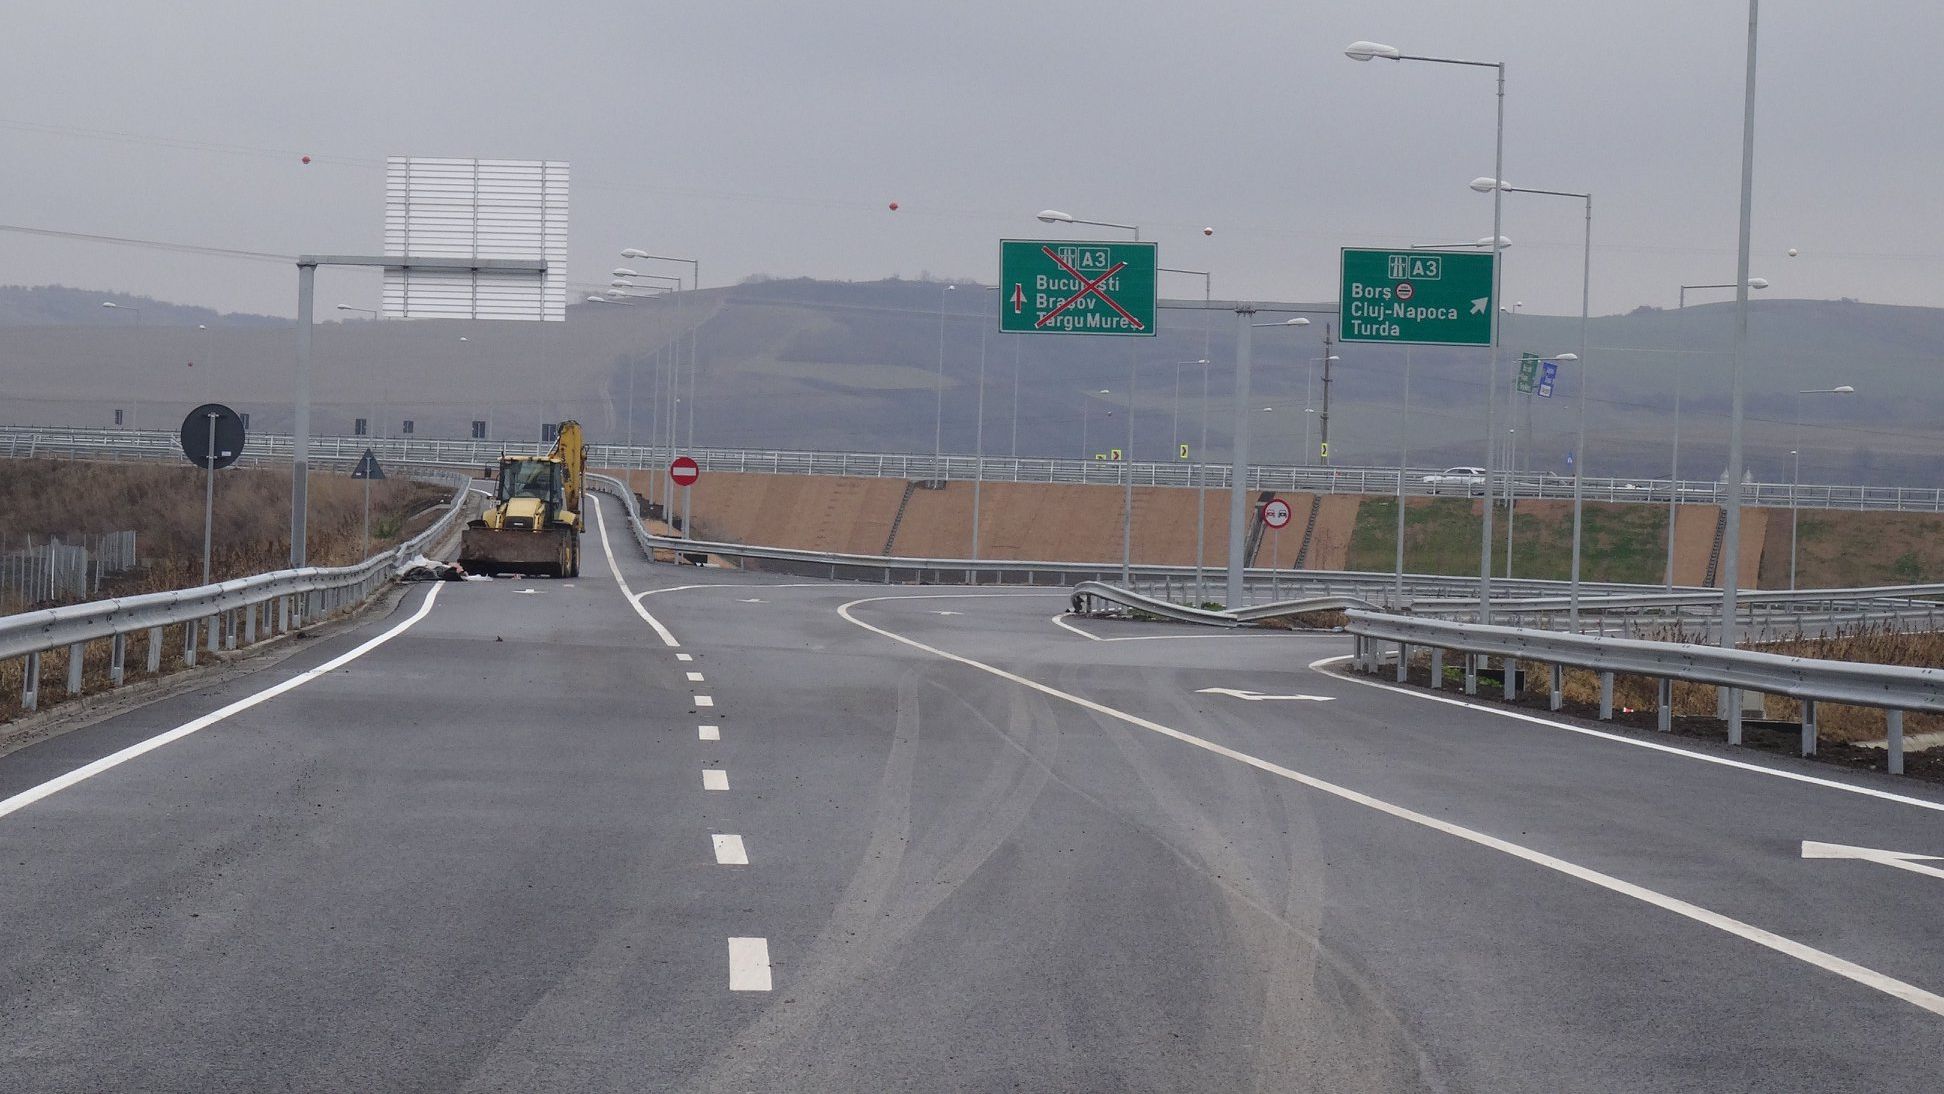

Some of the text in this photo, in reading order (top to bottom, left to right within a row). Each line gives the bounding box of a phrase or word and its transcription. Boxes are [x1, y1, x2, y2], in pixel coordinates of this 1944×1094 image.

[1082, 252, 1106, 267] A3
[1412, 261, 1437, 276] A3
[1352, 283, 1391, 300] Borș
[1351, 302, 1458, 322] Cluj-Napoca
[1351, 320, 1400, 336] Turda
